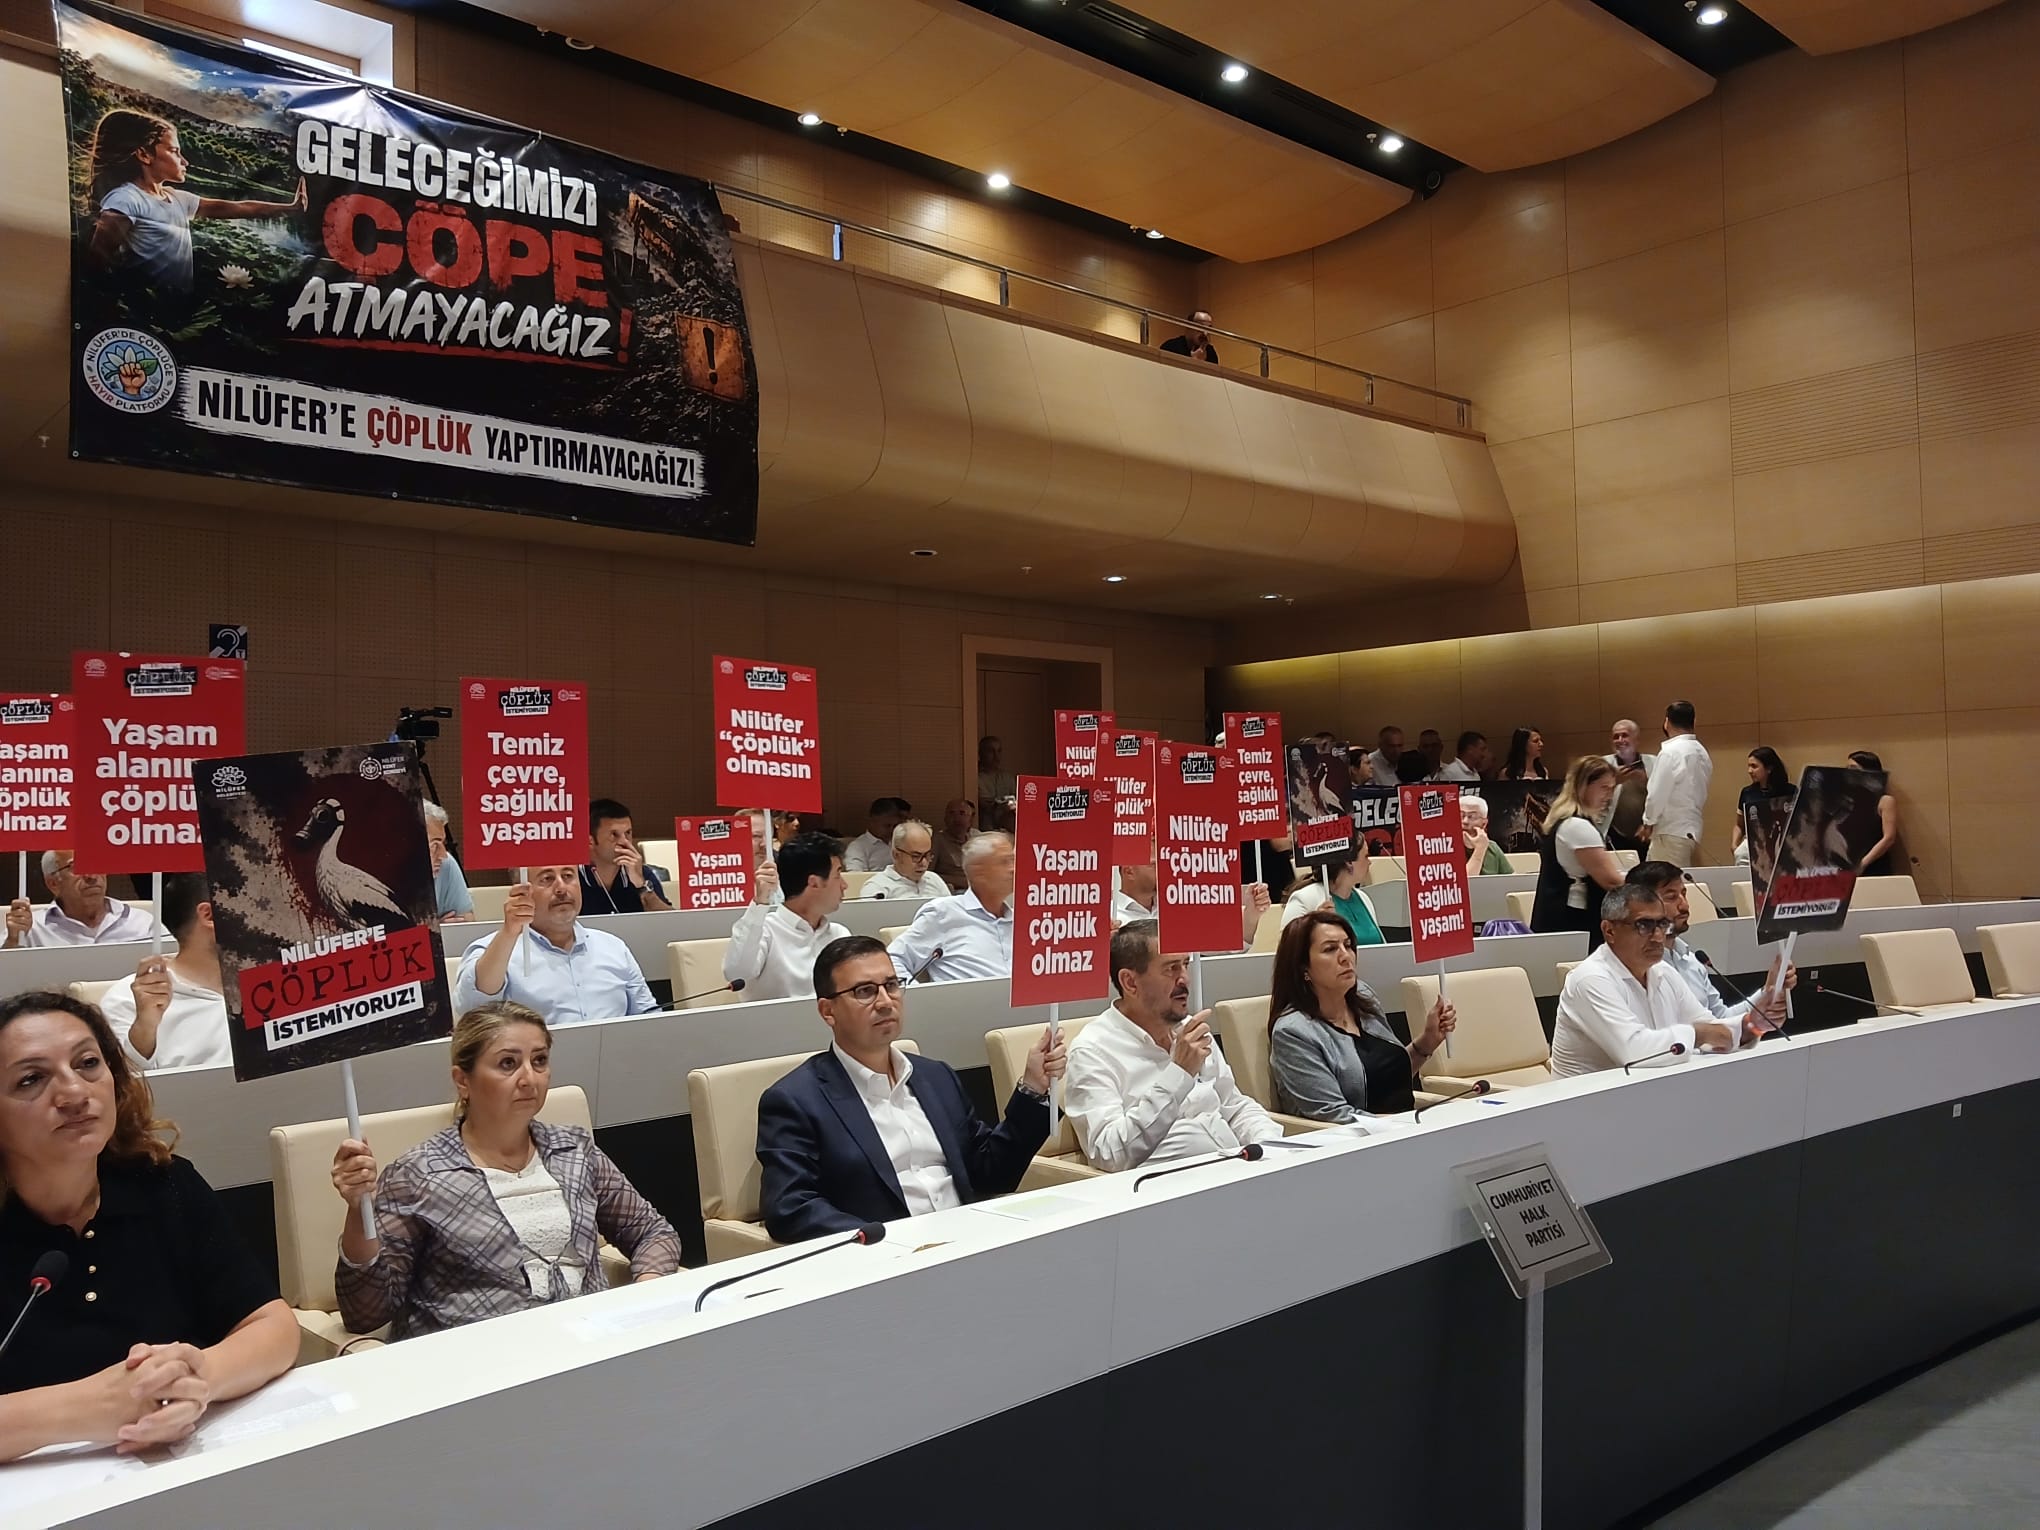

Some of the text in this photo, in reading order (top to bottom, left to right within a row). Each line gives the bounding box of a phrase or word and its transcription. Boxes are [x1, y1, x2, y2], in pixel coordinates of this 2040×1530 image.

[296, 119, 598, 227] GELECEĞİMİZİ
[322, 193, 608, 309] ÇÖPE
[88, 375, 170, 411] HAYIR PLATFORMU
[198, 377, 696, 488] NİLÜFER’E ÇÖPLÜK YAPTIRMAYACAĞIZ!
[500, 691, 551, 707] ÇÖPLÜK
[102, 718, 218, 750] Yaşam
[730, 708, 804, 733] Nilüfer
[0, 742, 69, 763] aşam
[488, 732, 565, 756] Temiz
[719, 730, 815, 757] “çöplük”
[1065, 746, 1096, 760] Nilüf
[1237, 748, 1273, 765] Temiz
[96, 751, 199, 778] alanı
[487, 765, 566, 788] çevre,
[726, 754, 811, 779] olmasın
[1060, 762, 1094, 778] “çöpl
[1181, 759, 1215, 773] ÇÖPLÜK
[1104, 777, 1147, 795] lüfer
[1239, 770, 1274, 787] çevre,
[0, 785, 71, 811] öplük
[101, 784, 198, 817] çöplü
[480, 788, 573, 817] sağlıklı
[1048, 792, 1088, 809] ÇÖPLÜK
[1238, 786, 1278, 805] sağlıklı
[0, 811, 68, 831] lmaz
[1169, 815, 1229, 843] Nilüfer
[1238, 805, 1280, 826] yaşam!
[107, 818, 203, 845] olma
[481, 819, 574, 846] yaşam!
[1416, 832, 1454, 856] Temiz
[1032, 843, 1098, 876] Yaşam
[1305, 839, 1347, 854] İSTEMİYORUZ!
[690, 852, 742, 870] Yaşam
[1160, 847, 1238, 879] “çöplük”
[1419, 863, 1456, 886] çevre,
[688, 870, 746, 887] alanına
[691, 886, 745, 908] çöplük
[1027, 880, 1101, 907] alanına
[1166, 879, 1235, 906] olmasın
[1418, 883, 1462, 911] sağlıklı
[1029, 910, 1097, 946] çöplük
[1420, 909, 1465, 940] yaşam!
[281, 924, 387, 966] NİLÜFER’E
[1031, 945, 1093, 976] olmaz
[251, 942, 427, 1022] ÇÖPLÜK
[273, 986, 416, 1042] İSTEMİYORUZ!
[1489, 1179, 1555, 1210] CUMHURİYET
[1519, 1205, 1550, 1225] HALK
[1525, 1219, 1566, 1248] PARTİSİ
